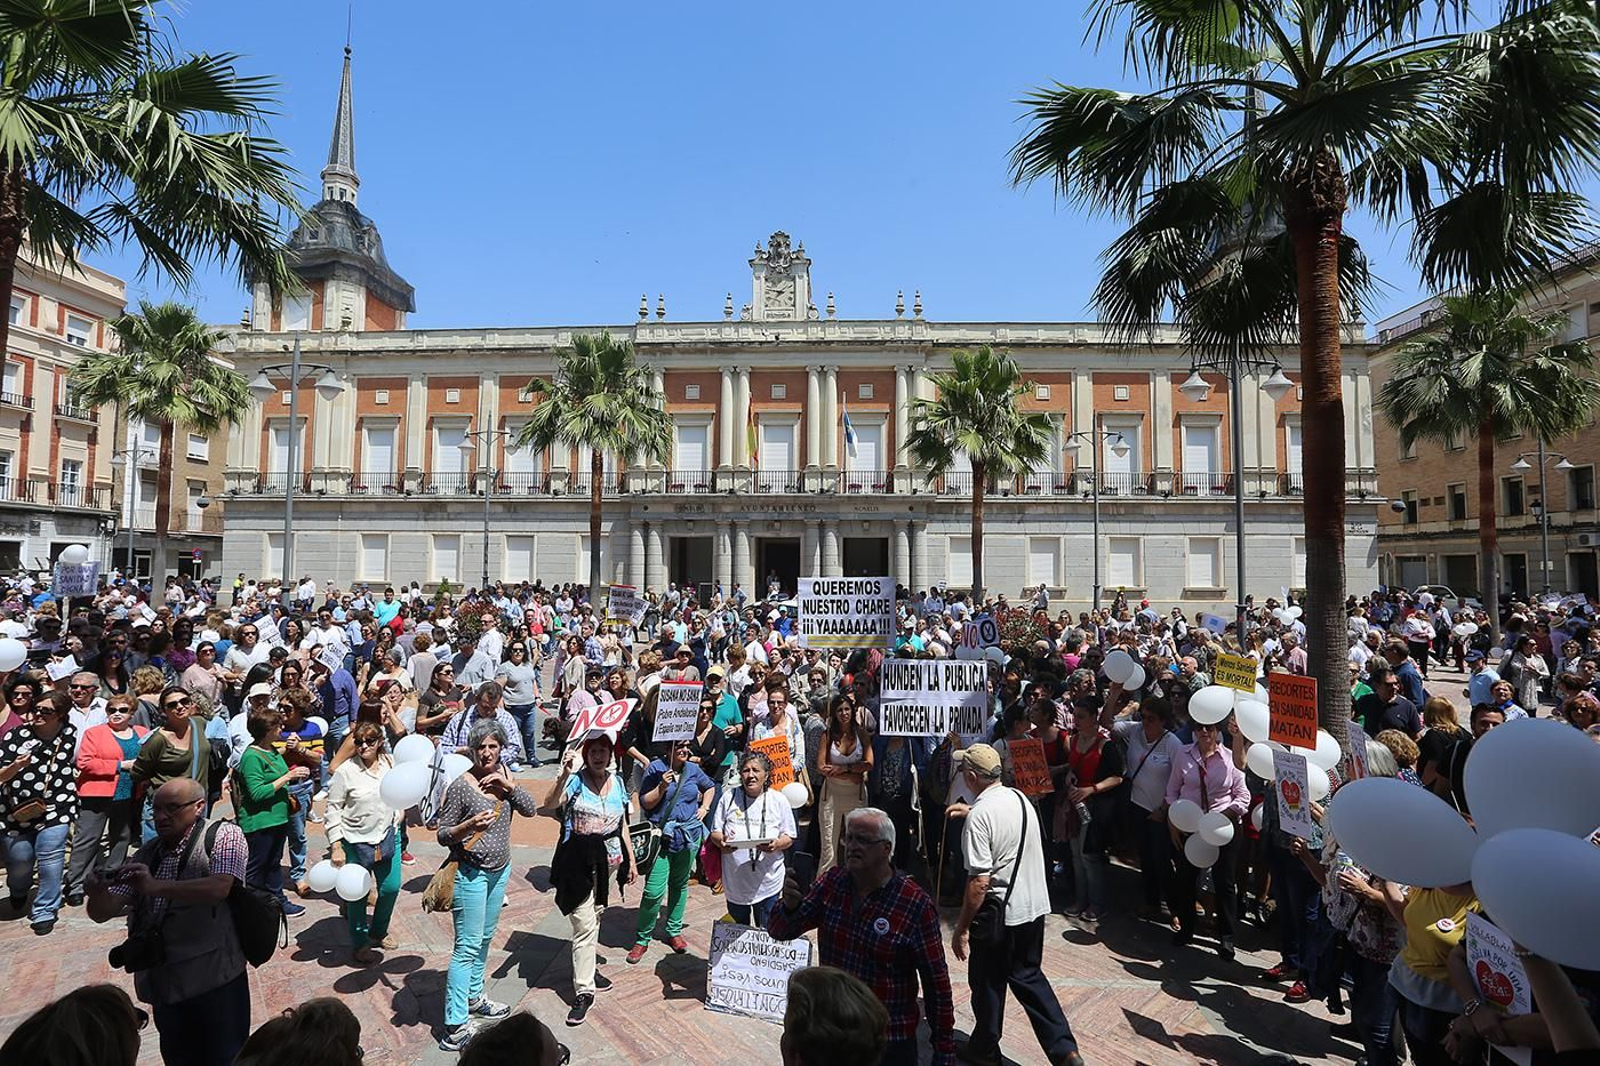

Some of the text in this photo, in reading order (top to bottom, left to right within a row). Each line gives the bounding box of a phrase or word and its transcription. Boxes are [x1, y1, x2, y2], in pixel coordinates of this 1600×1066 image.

[812, 581, 881, 595] QUEREMOS
[803, 599, 890, 615] NUESTRO CHARE
[883, 664, 985, 692] HUNDEN LA PUBLICA
[1270, 681, 1314, 701] RECORTES
[569, 700, 629, 739] NO
[884, 705, 983, 734] FAVORECEN LA PRIVADA
[1270, 701, 1315, 721] EN SANIDAD
